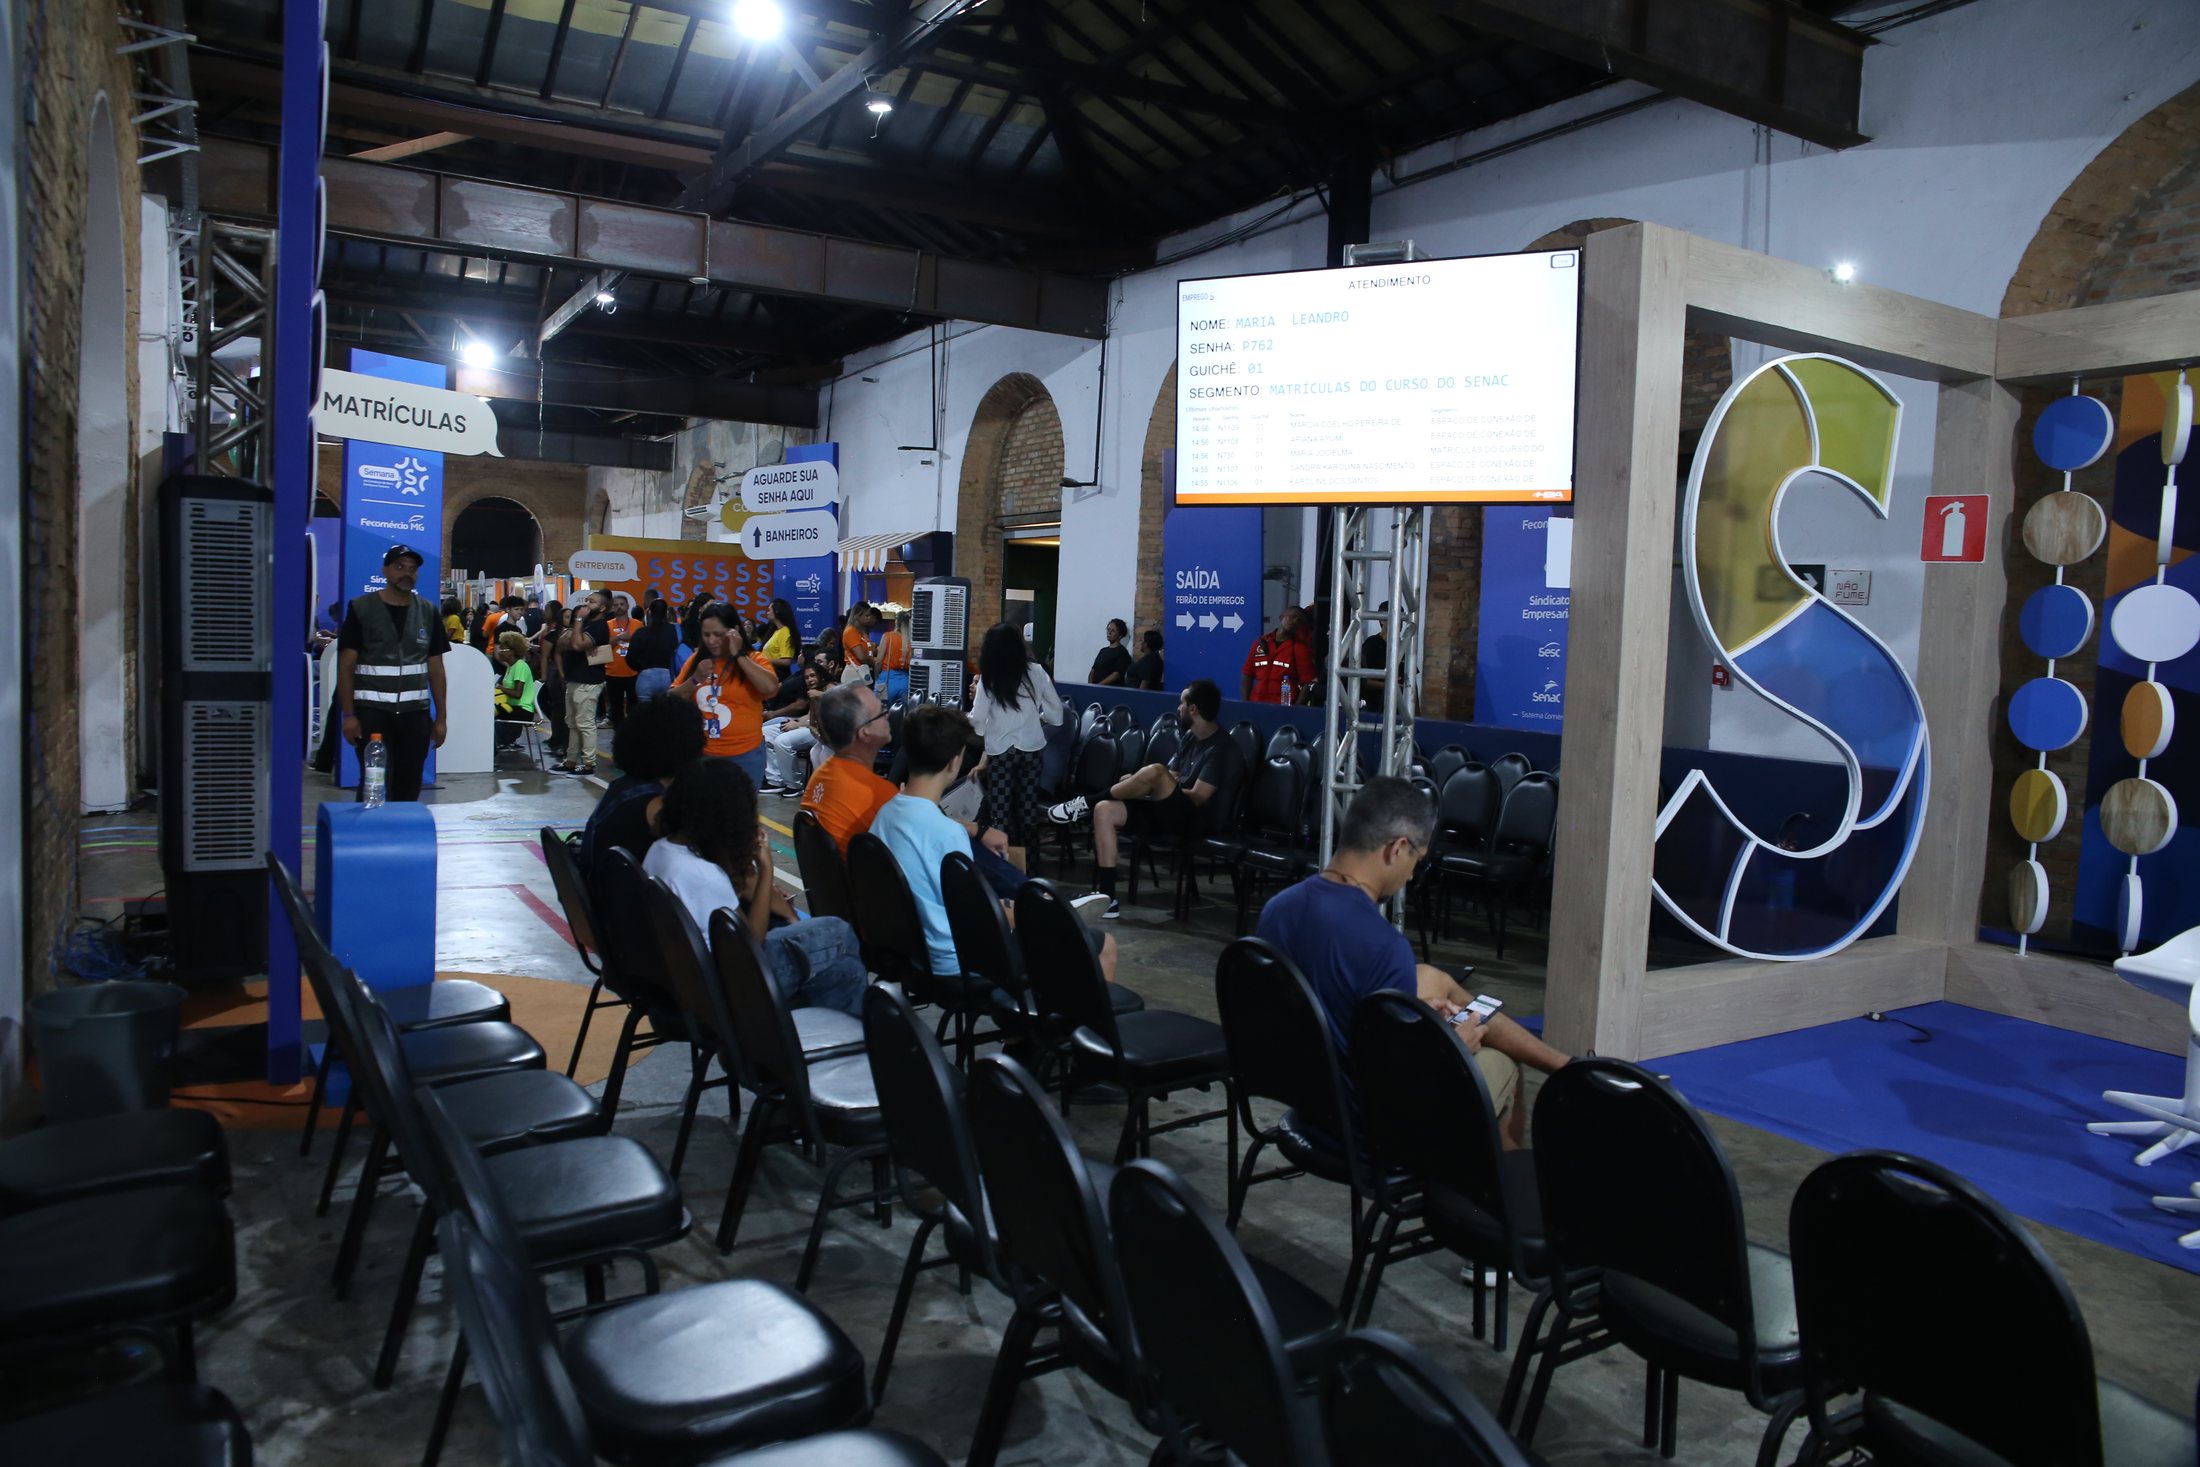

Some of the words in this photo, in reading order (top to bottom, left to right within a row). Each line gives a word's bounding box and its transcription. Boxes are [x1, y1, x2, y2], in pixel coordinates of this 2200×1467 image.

[1348, 275, 1431, 290] ATENDIMENTO
[1190, 318, 1230, 331] NOME:
[1235, 316, 1275, 329] MARIA
[1292, 310, 1350, 326] LEANDRO
[1189, 342, 1236, 354] SENHA:
[1242, 339, 1273, 352] P762
[1247, 362, 1264, 375] 01
[1189, 385, 1263, 399] SEGMENTO:
[1359, 380, 1377, 392] DO
[1385, 377, 1429, 391] CURSO
[1437, 376, 1455, 389] DO
[1464, 374, 1510, 388] SENAC
[323, 391, 467, 433] MATRÍCULAS
[364, 468, 395, 478] Semana
[753, 470, 797, 486] AGUARDE
[799, 469, 819, 482] SUA
[758, 490, 788, 504] SENHA
[790, 488, 814, 501] AQUI
[360, 518, 409, 530] Fecomércio
[410, 523, 425, 532] MG
[765, 527, 819, 542] BANHEIROS
[575, 560, 625, 570] ENTREVISTA
[1175, 565, 1220, 590] SAÍDA
[1836, 580, 1858, 590] NÃO
[1175, 593, 1198, 604] FEIRÃO
[1199, 595, 1208, 605] DE
[1208, 596, 1245, 605] EMPREGOS
[1835, 591, 1865, 599] FUME
[1538, 647, 1561, 658] Sesc
[1532, 691, 1561, 703] Senac
[1521, 711, 1544, 720] Sistema
